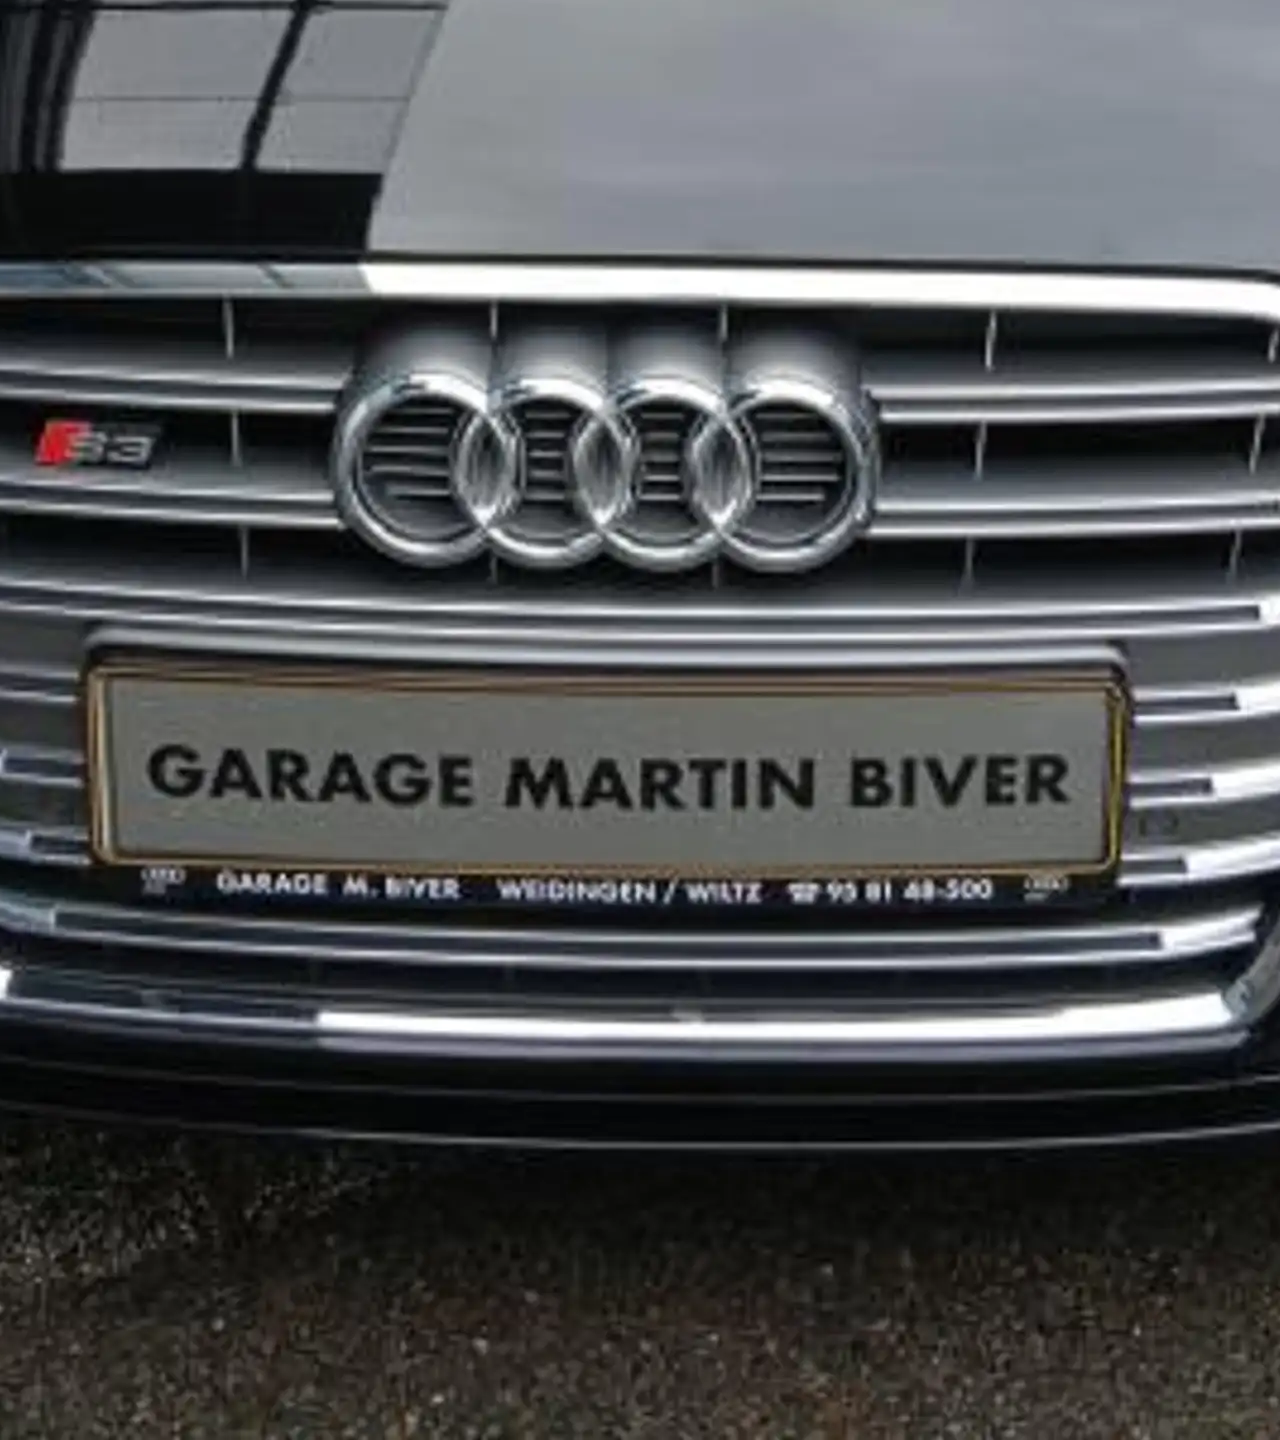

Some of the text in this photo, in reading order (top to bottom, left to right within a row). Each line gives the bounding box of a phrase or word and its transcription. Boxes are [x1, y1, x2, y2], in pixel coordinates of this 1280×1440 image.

[58, 428, 156, 466] S3
[146, 743, 1070, 810] GARAGE MARTIN BIVER
[216, 869, 329, 896] GARAGE
[342, 873, 381, 898] M.
[385, 876, 462, 900] BIVER
[496, 877, 657, 904] WEIDINGEN
[685, 881, 764, 905] WILTZ
